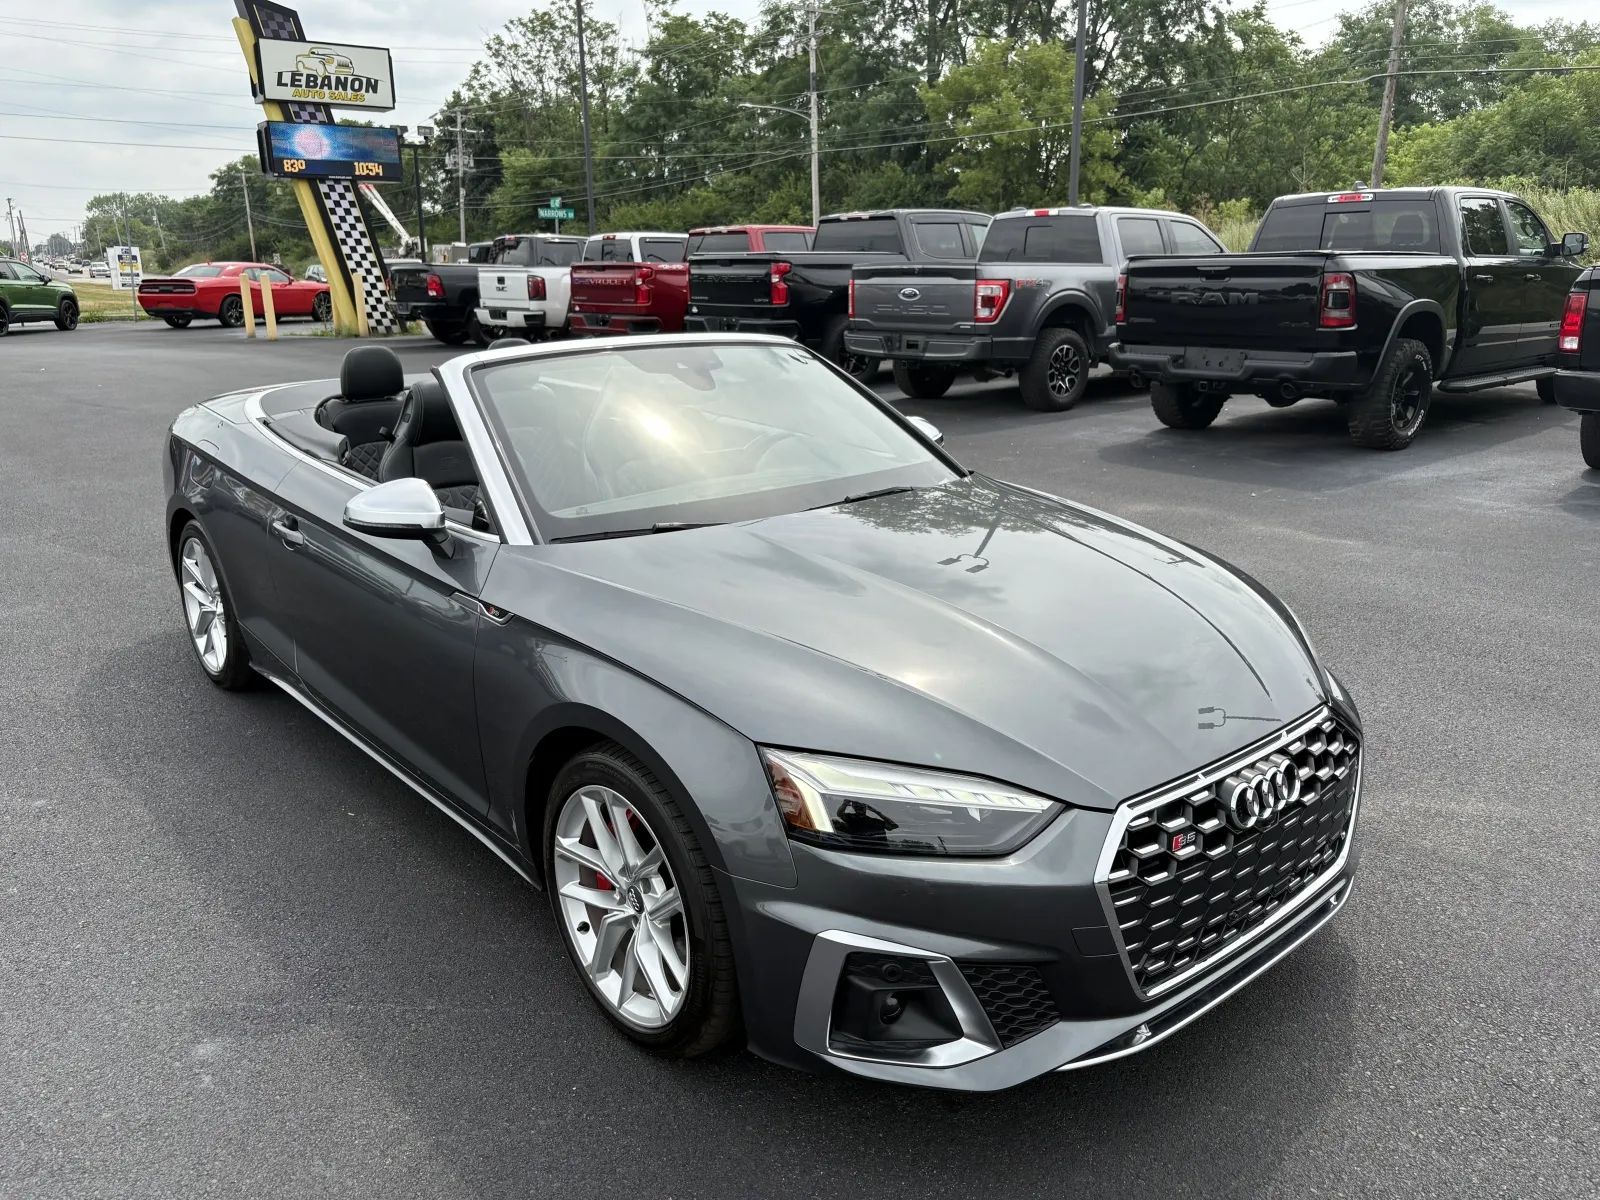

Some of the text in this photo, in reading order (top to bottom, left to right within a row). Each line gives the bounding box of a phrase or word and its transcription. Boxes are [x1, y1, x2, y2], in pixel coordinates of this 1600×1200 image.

[276, 71, 379, 94] LEBANON
[292, 88, 366, 102] AUTO SALES
[1171, 292, 1259, 305] RAM
